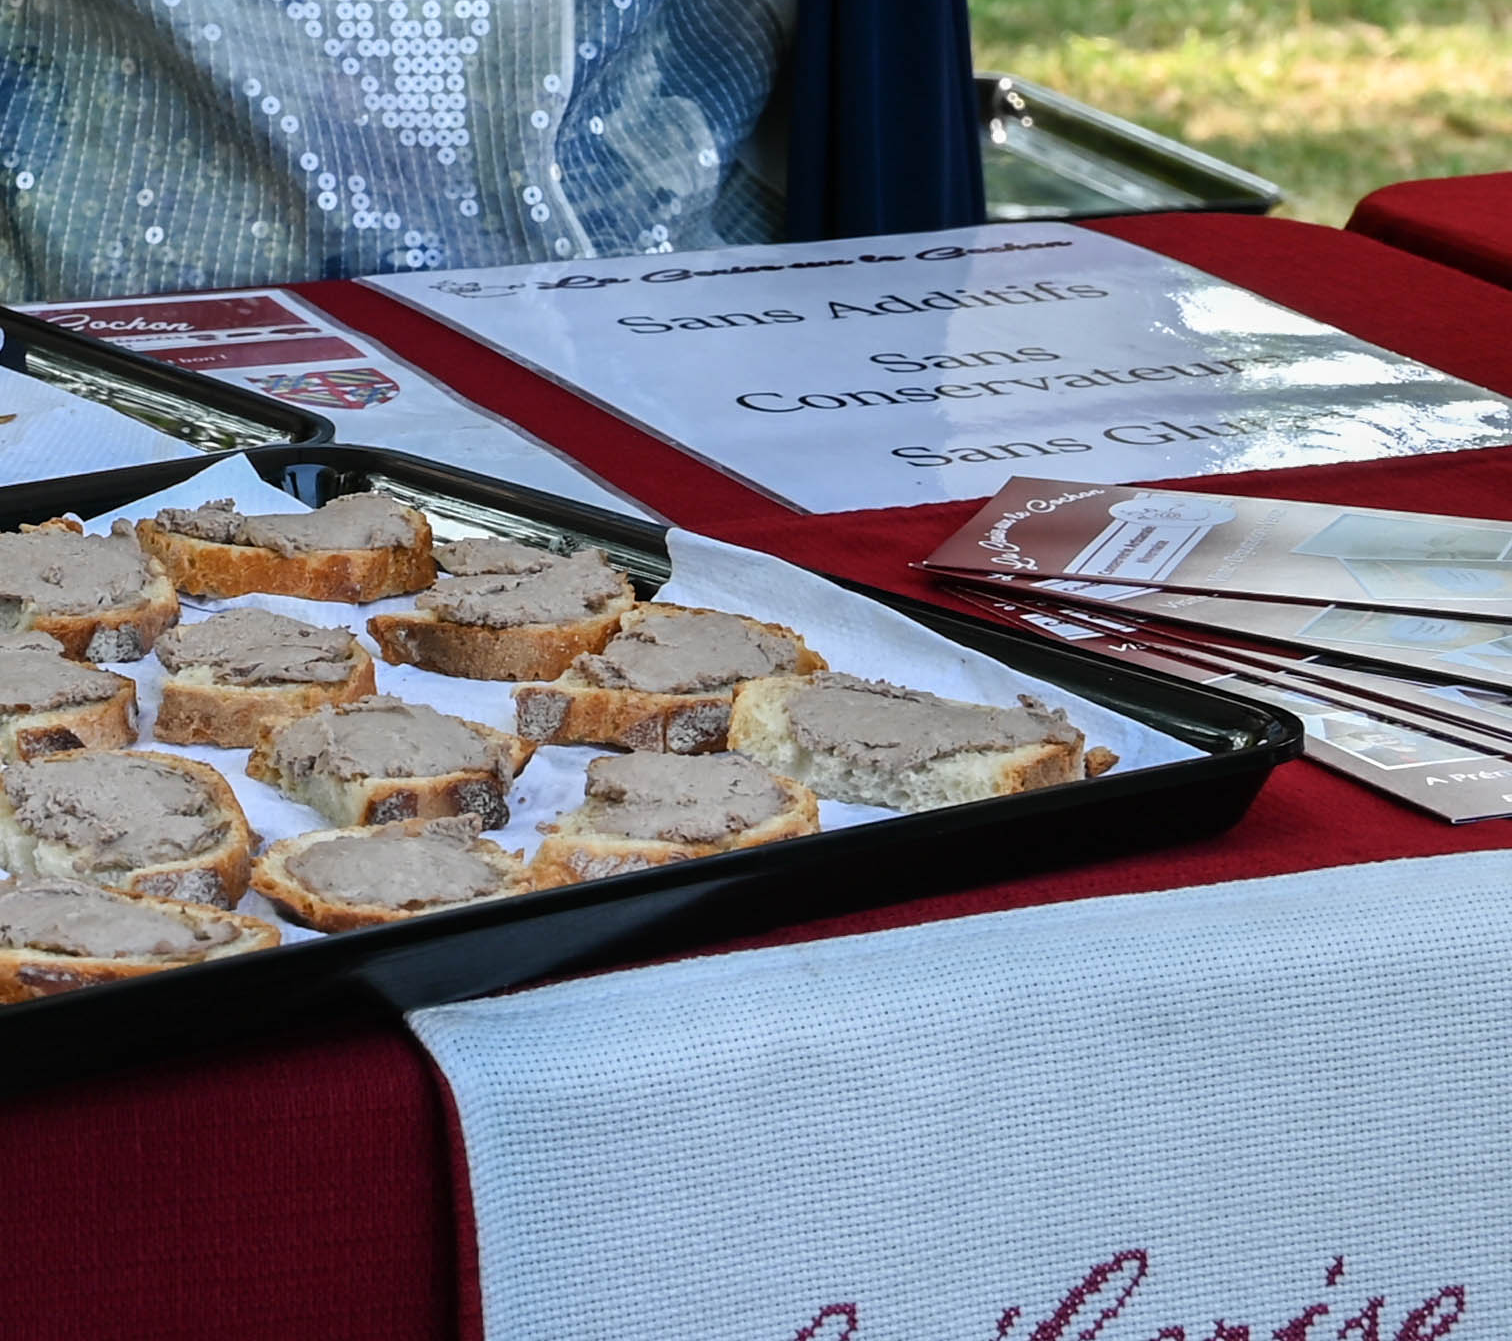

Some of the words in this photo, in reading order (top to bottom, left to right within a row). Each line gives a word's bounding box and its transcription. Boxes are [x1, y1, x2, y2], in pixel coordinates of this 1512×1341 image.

[616, 304, 806, 335] Sans
[827, 280, 1109, 321] Additifs
[869, 343, 1062, 374] Sans
[891, 431, 1094, 469] Sans
